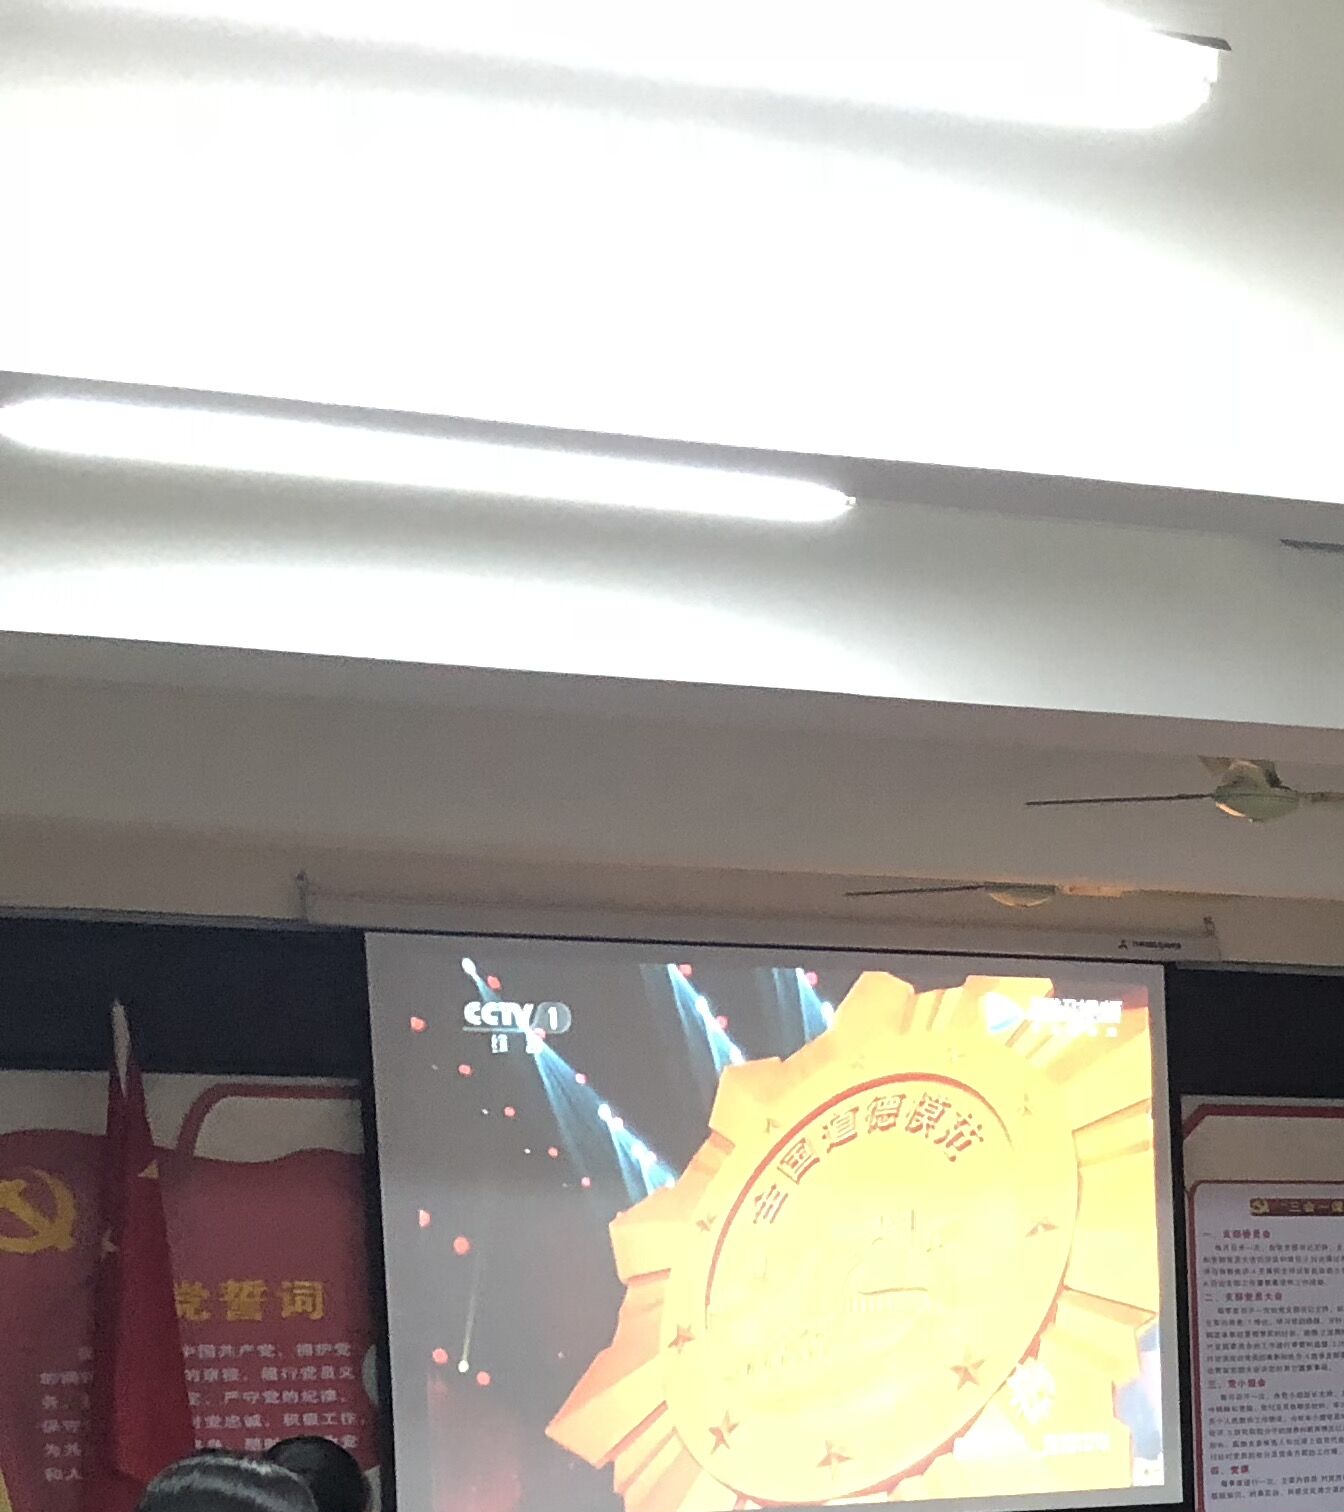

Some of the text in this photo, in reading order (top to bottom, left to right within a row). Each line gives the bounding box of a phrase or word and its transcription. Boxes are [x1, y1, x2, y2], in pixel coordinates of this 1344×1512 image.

[463, 1001, 534, 1027] CCTV
[752, 1091, 985, 1225] 全国道德模范
